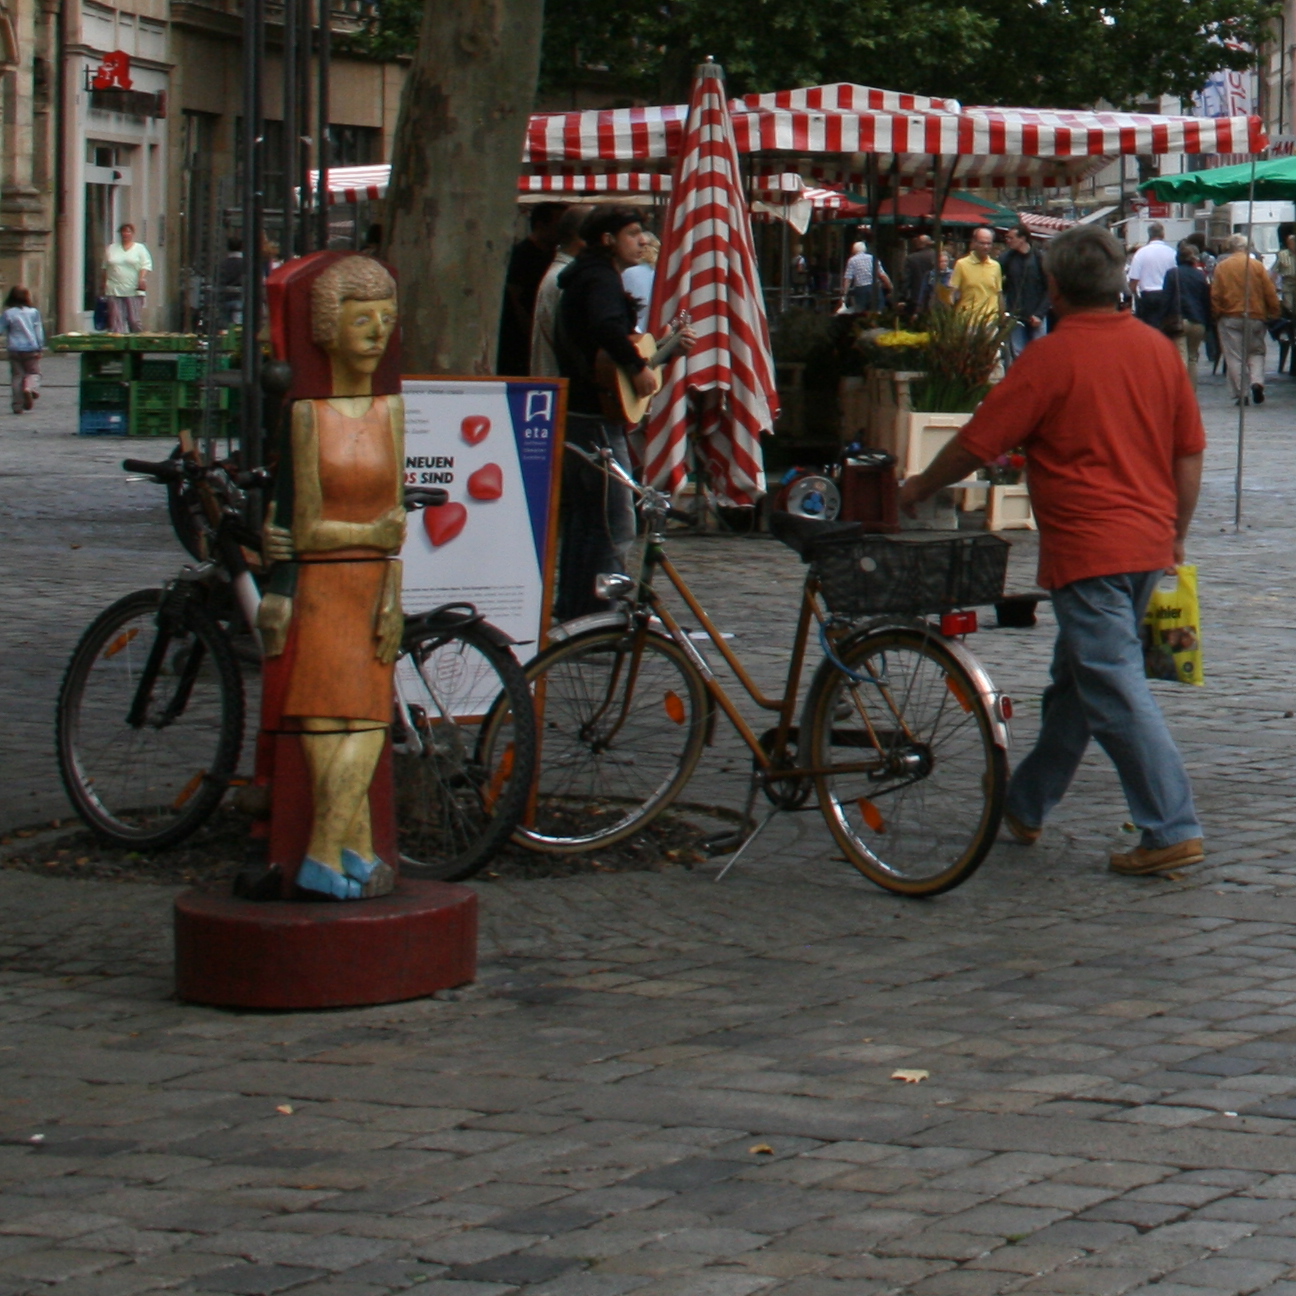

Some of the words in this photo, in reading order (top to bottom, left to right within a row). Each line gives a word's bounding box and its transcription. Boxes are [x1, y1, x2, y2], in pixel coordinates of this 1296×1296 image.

[524, 427, 548, 439] eta
[406, 456, 454, 468] NEUEN
[420, 472, 454, 484] SIND
